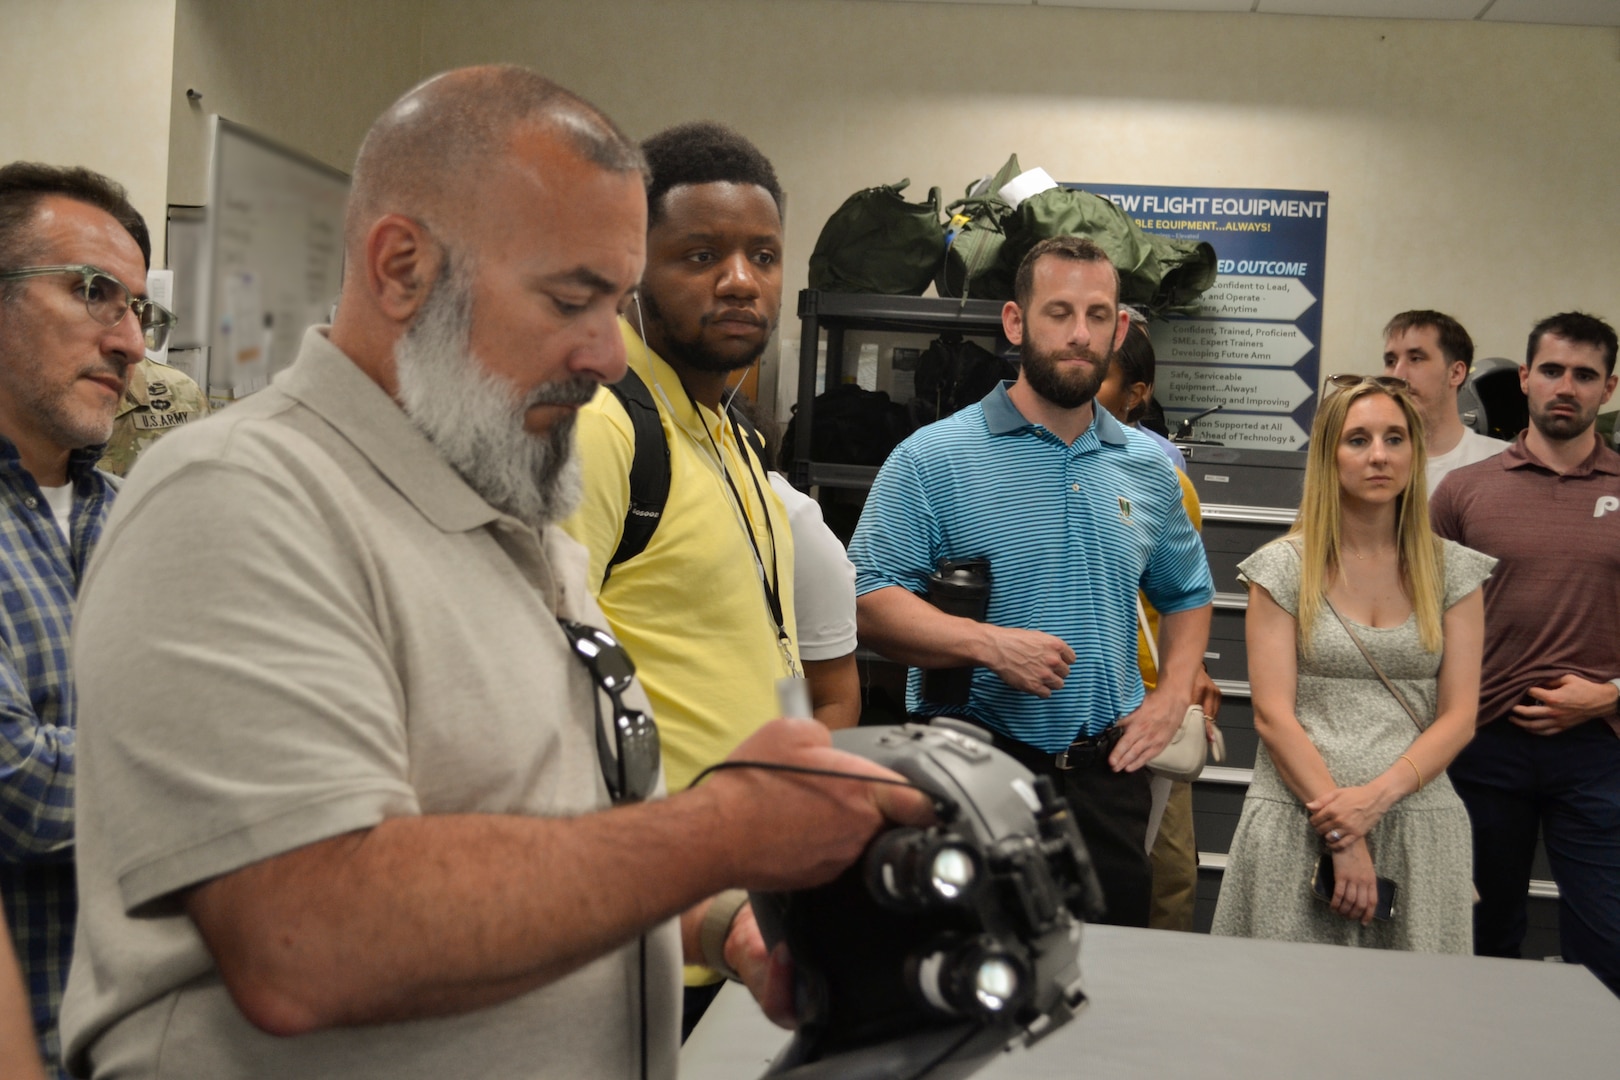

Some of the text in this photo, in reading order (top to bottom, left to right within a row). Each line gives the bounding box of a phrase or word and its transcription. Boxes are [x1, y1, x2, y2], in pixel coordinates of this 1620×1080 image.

[1143, 196, 1209, 215] FLIGHT
[1211, 198, 1326, 219] EQUIPMENT
[1237, 260, 1307, 276] OUTCOME
[1212, 280, 1290, 293] Confident to Lead,
[1208, 293, 1225, 301] and
[1226, 294, 1260, 305] Operate
[1221, 304, 1258, 315] Anytime
[1172, 325, 1297, 338] Confident, Trained, Proficient
[1201, 337, 1229, 347] Expert
[1230, 339, 1264, 348] Trainers
[1171, 348, 1271, 360] Developing Future Amn
[1170, 370, 1242, 381] Safe, Serviceable
[1169, 394, 1290, 408] Ever-Evolving and Improving
[1214, 420, 1259, 432] Supported
[1260, 422, 1269, 430] at
[1270, 422, 1283, 431] All
[1228, 432, 1238, 441] of
[1239, 433, 1287, 445] Technology
[1289, 435, 1296, 443] &
[1593, 495, 1619, 518] P
